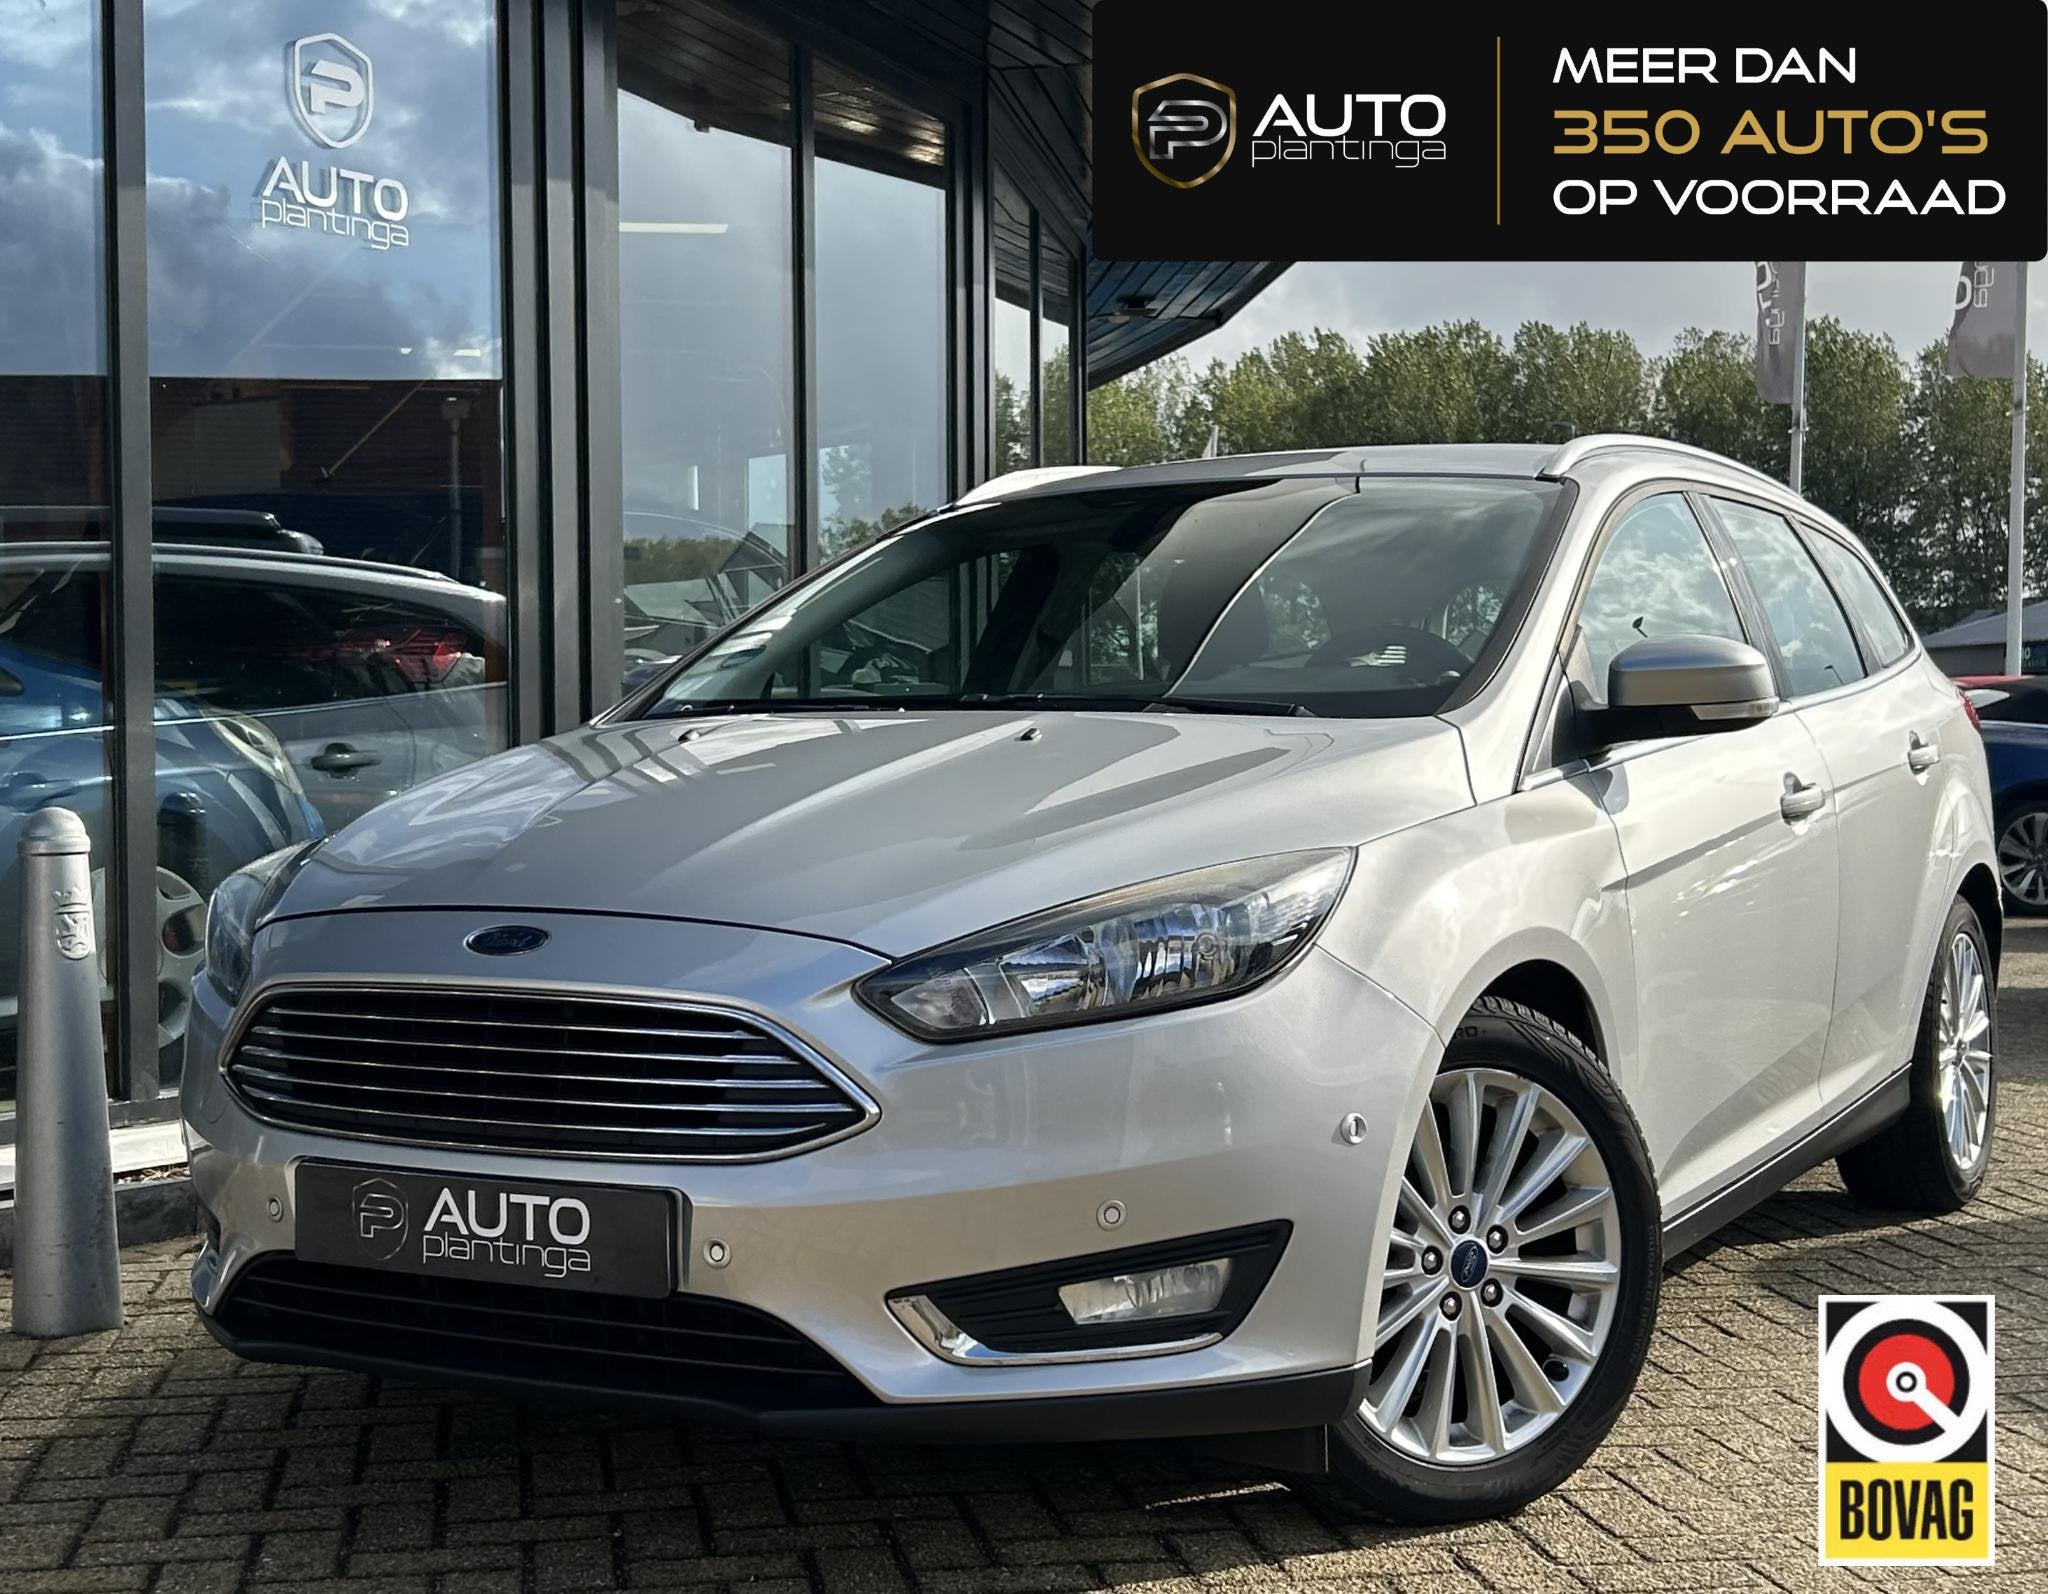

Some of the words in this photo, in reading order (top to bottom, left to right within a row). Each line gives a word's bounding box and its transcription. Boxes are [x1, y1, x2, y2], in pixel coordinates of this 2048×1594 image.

[262, 156, 409, 222] AUTO
[261, 198, 410, 250] plantinga
[423, 1187, 590, 1245] AUTO
[422, 1231, 591, 1278] plantinga
